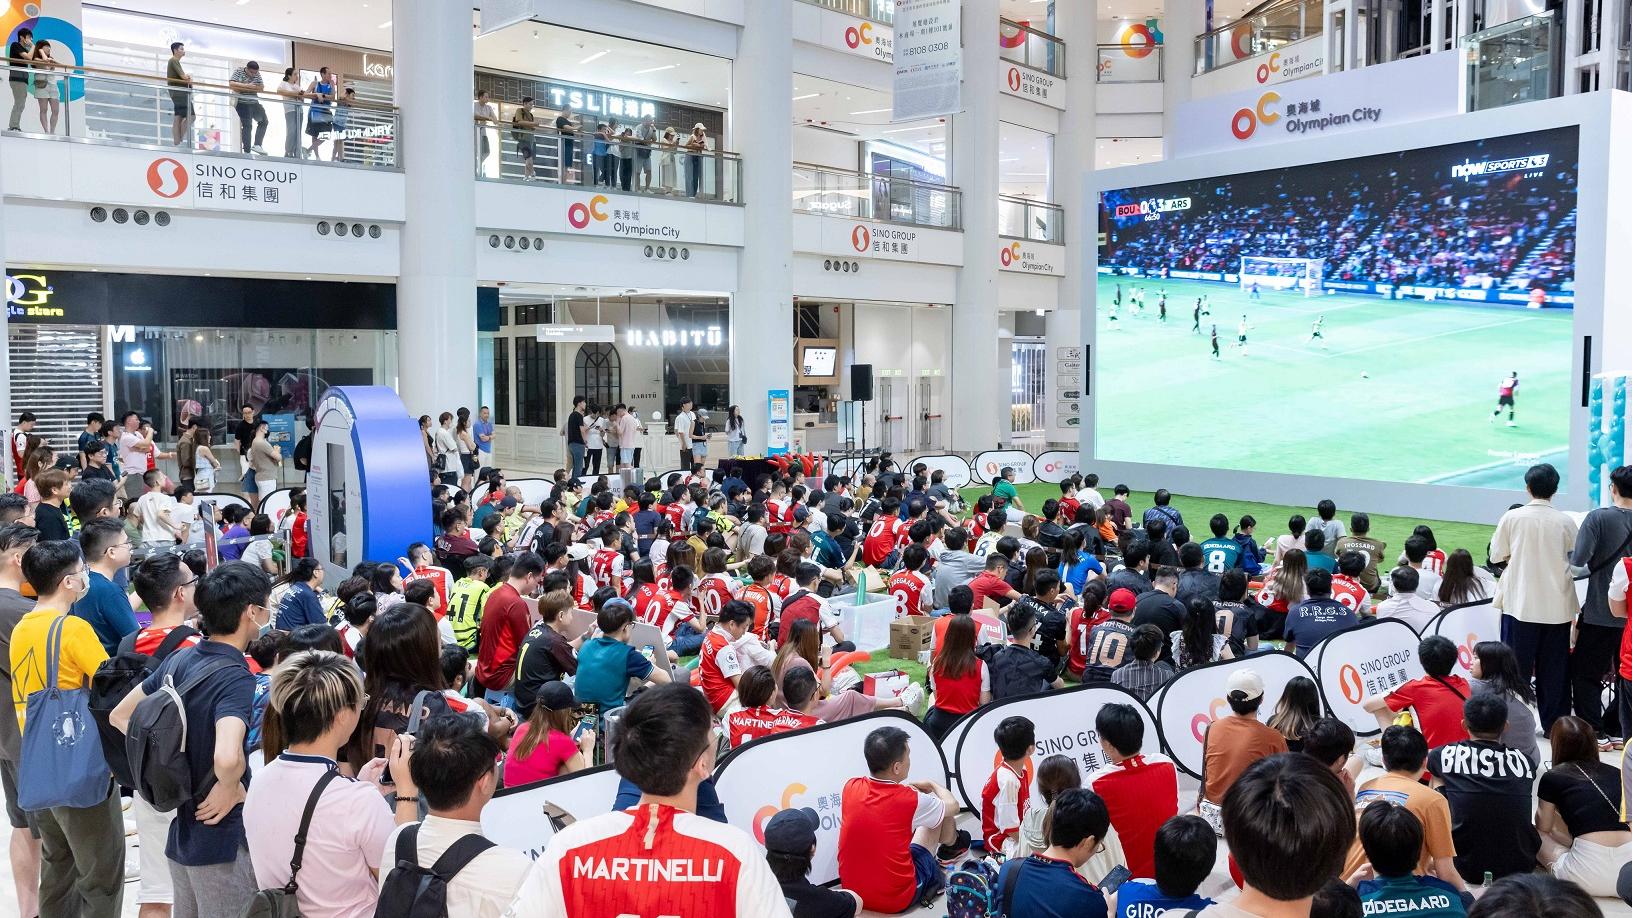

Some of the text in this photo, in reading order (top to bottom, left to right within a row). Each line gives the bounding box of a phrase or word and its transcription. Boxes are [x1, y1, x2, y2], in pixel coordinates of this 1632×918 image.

[909, 46, 927, 56] 8108
[928, 42, 949, 52] 0308
[1283, 63, 1313, 76] Olympian
[551, 88, 600, 111] TSL
[1286, 99, 1321, 117] 奧海城
[1232, 92, 1281, 140] OC
[1286, 107, 1382, 133] Olympian City
[195, 164, 298, 184] SINO GROUP
[1487, 159, 1528, 172] SPORTS
[1523, 171, 1544, 179] LIVE
[196, 181, 280, 204] 信和集團
[568, 194, 609, 230] OC
[1118, 206, 1136, 216] BOU
[1170, 199, 1188, 210] ARS
[613, 222, 680, 239] Olympian City
[872, 228, 916, 242] SINO GROUP
[1343, 542, 1375, 551] TROSSARD
[1208, 550, 1226, 573] 8
[1331, 579, 1357, 593] AVERTZ
[1115, 621, 1135, 632] ROW
[1089, 630, 1128, 668] 10
[1360, 649, 1411, 675] SINO GROUP
[1366, 668, 1409, 696] 信和集團
[1036, 735, 1073, 756] SINO
[573, 857, 725, 882] MARTINELLI
[1362, 894, 1450, 917] ØDEGAARD
